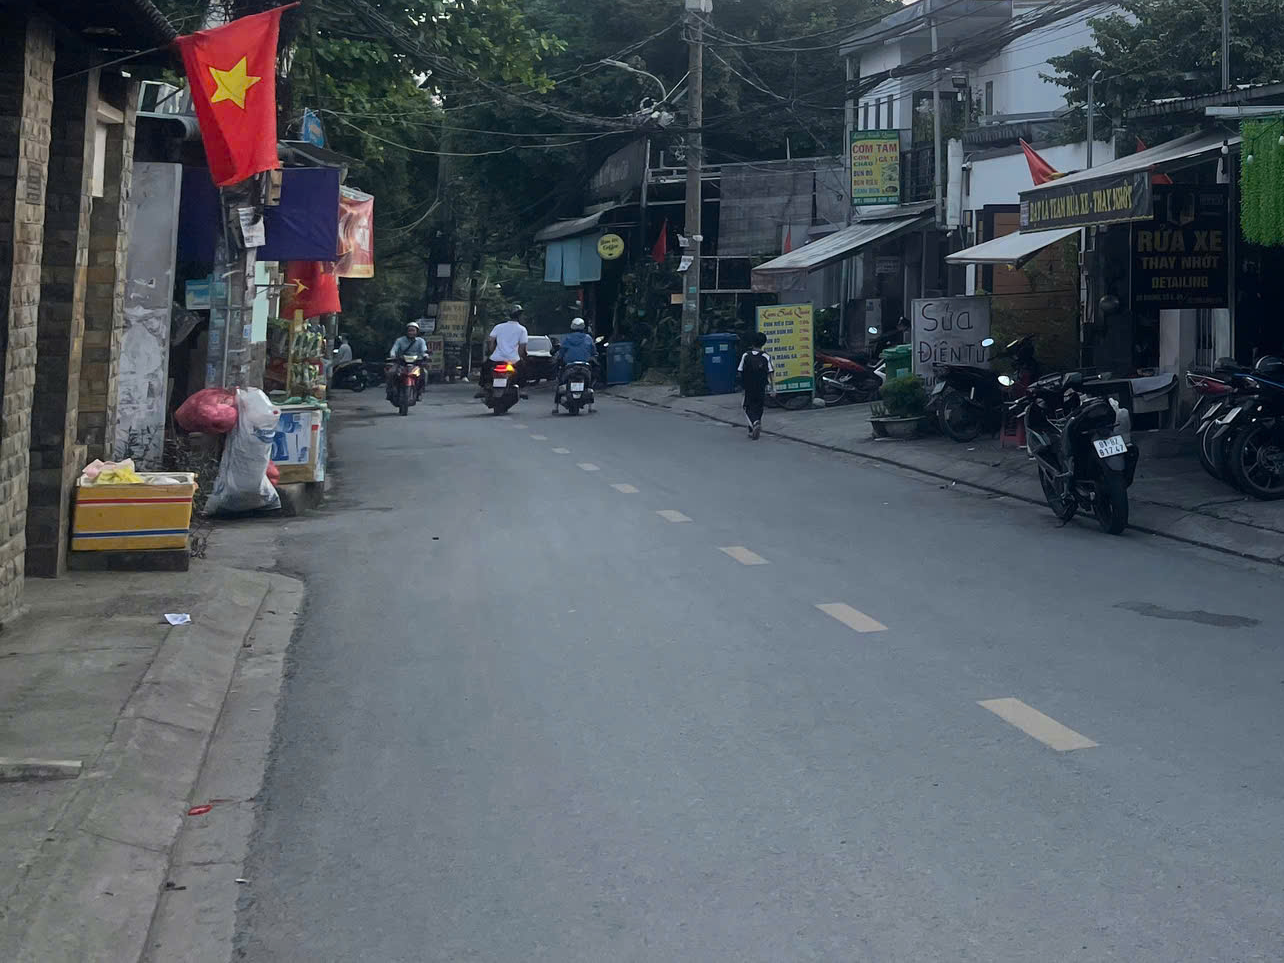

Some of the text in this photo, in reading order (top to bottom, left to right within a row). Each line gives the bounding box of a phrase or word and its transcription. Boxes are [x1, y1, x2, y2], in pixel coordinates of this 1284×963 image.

[1193, 230, 1223, 252] XE
[1142, 256, 1176, 270] THAY
[1151, 276, 1209, 289] DETAILING
